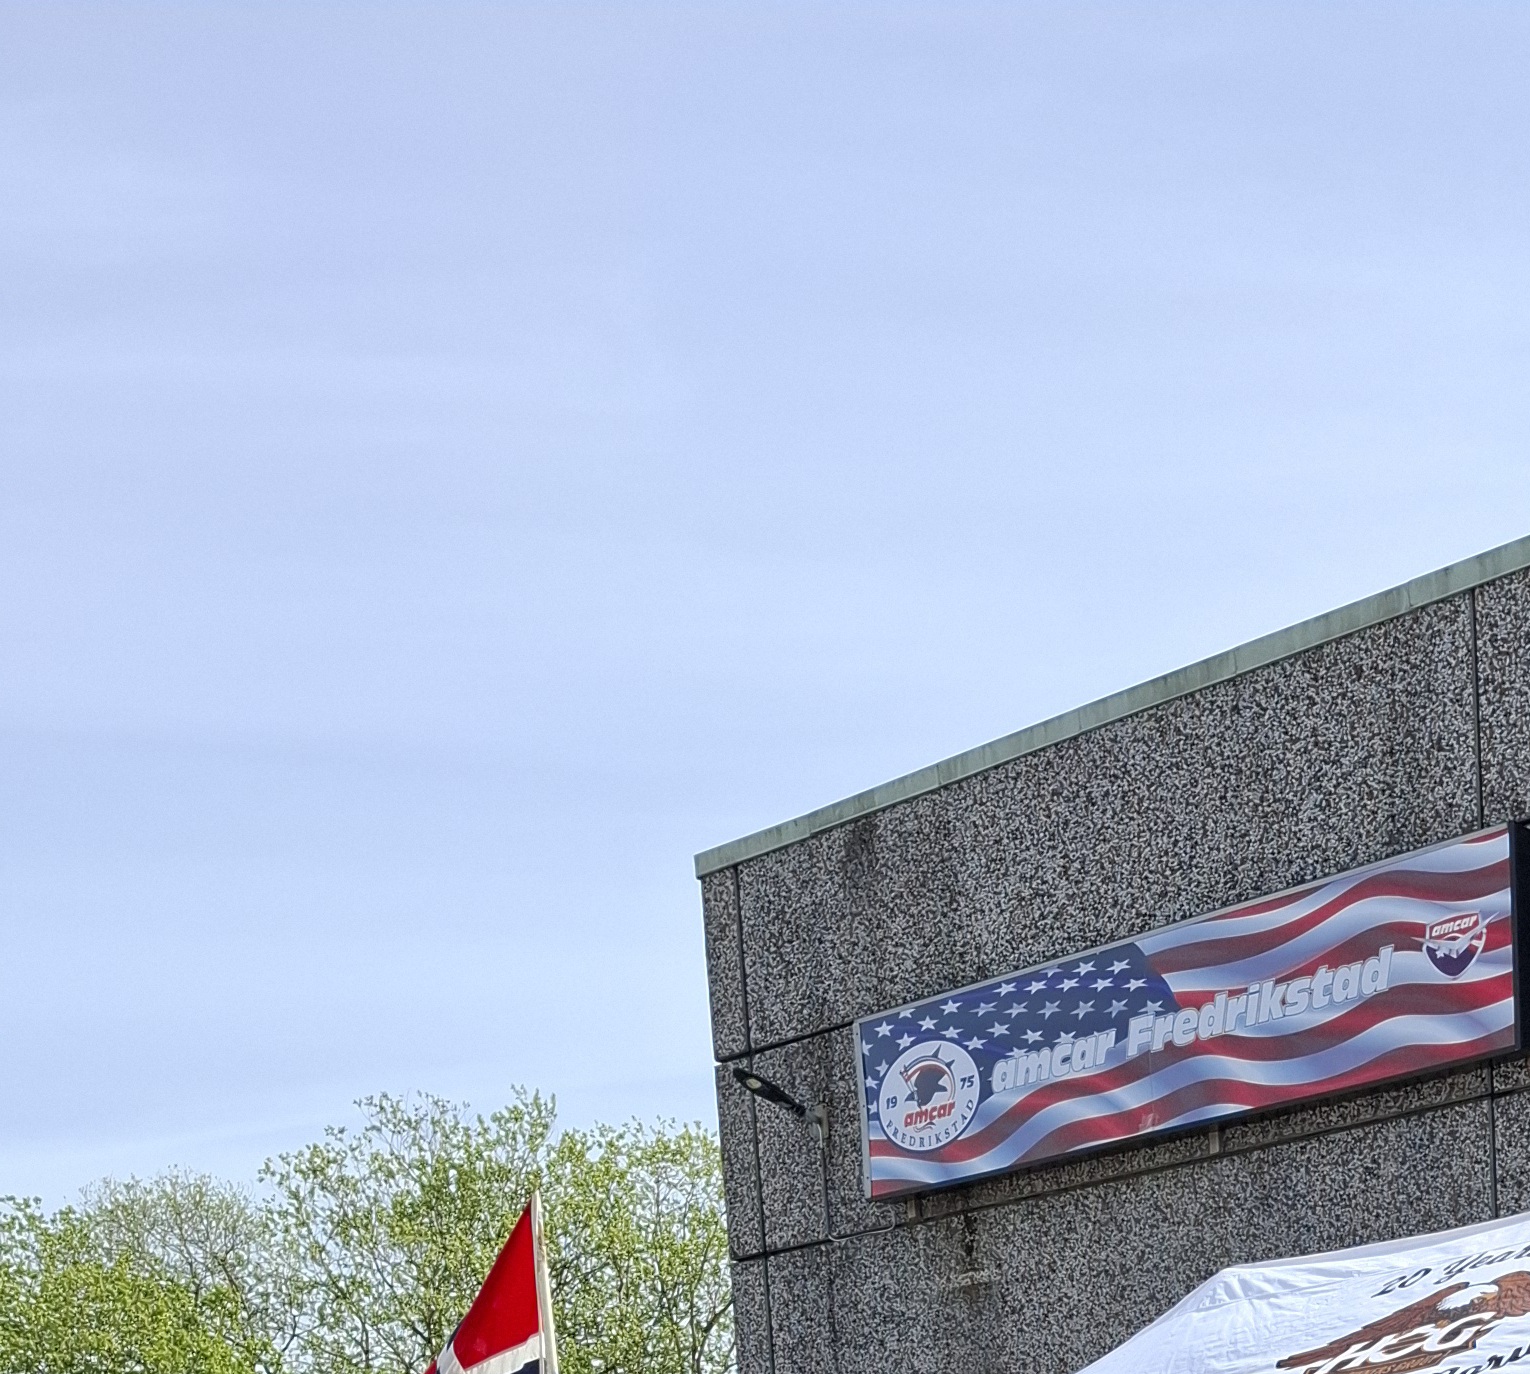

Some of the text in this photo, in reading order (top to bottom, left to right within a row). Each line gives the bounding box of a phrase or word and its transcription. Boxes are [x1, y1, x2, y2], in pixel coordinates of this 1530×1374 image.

[1431, 914, 1478, 937] amcar
[990, 944, 1396, 1094] amcar Fredrikstad
[960, 1074, 975, 1090] 75
[886, 1095, 898, 1110] 19
[903, 1101, 955, 1128] amcar
[886, 1099, 975, 1148] FREDRIKSTAD
